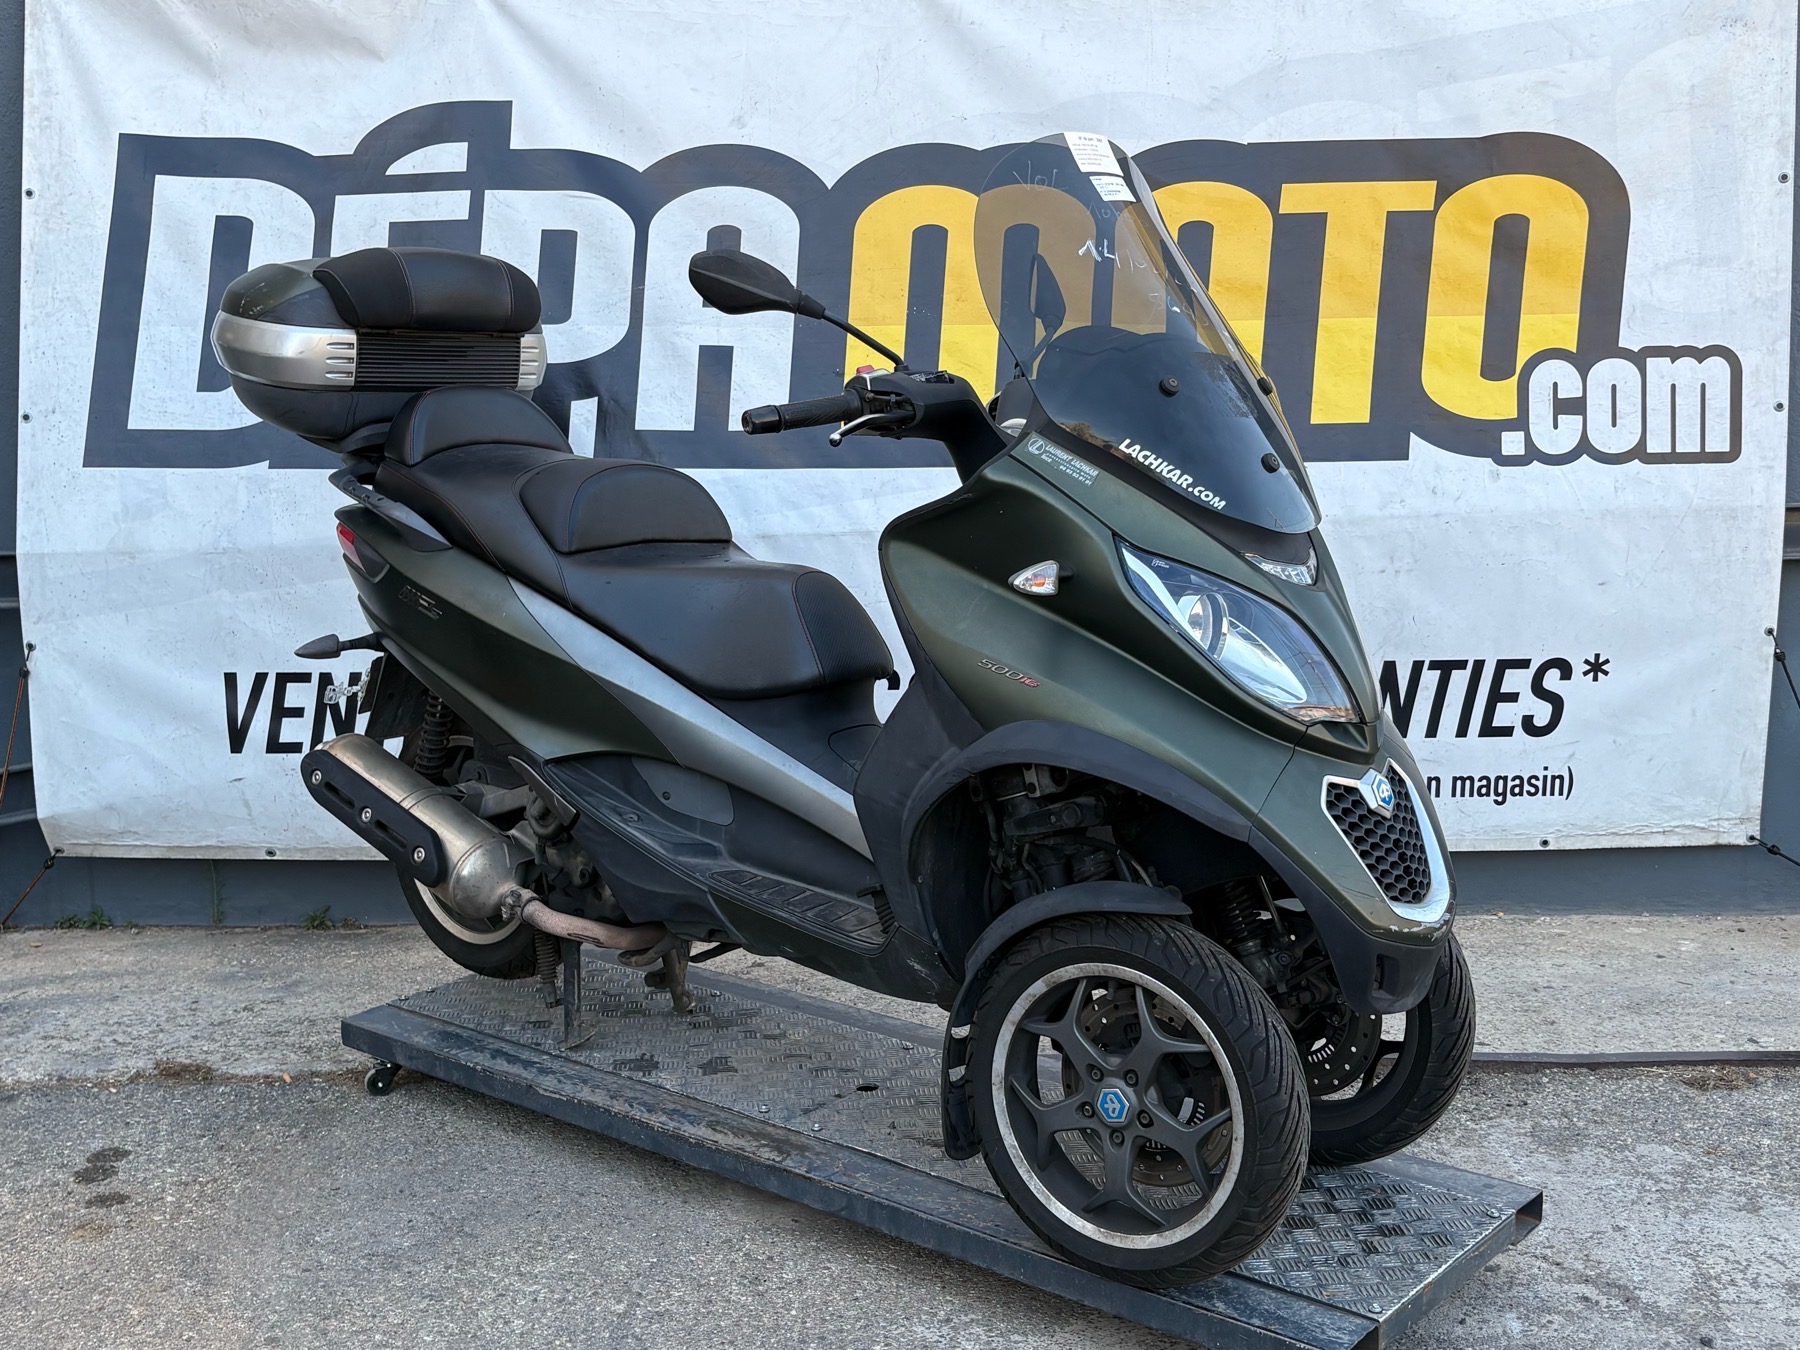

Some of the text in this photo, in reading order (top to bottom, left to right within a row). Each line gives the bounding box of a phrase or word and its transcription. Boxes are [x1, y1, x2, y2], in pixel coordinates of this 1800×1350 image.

[1045, 444, 1099, 477] LAURENT LACHKAR
[1450, 765, 1574, 806] magasin)
